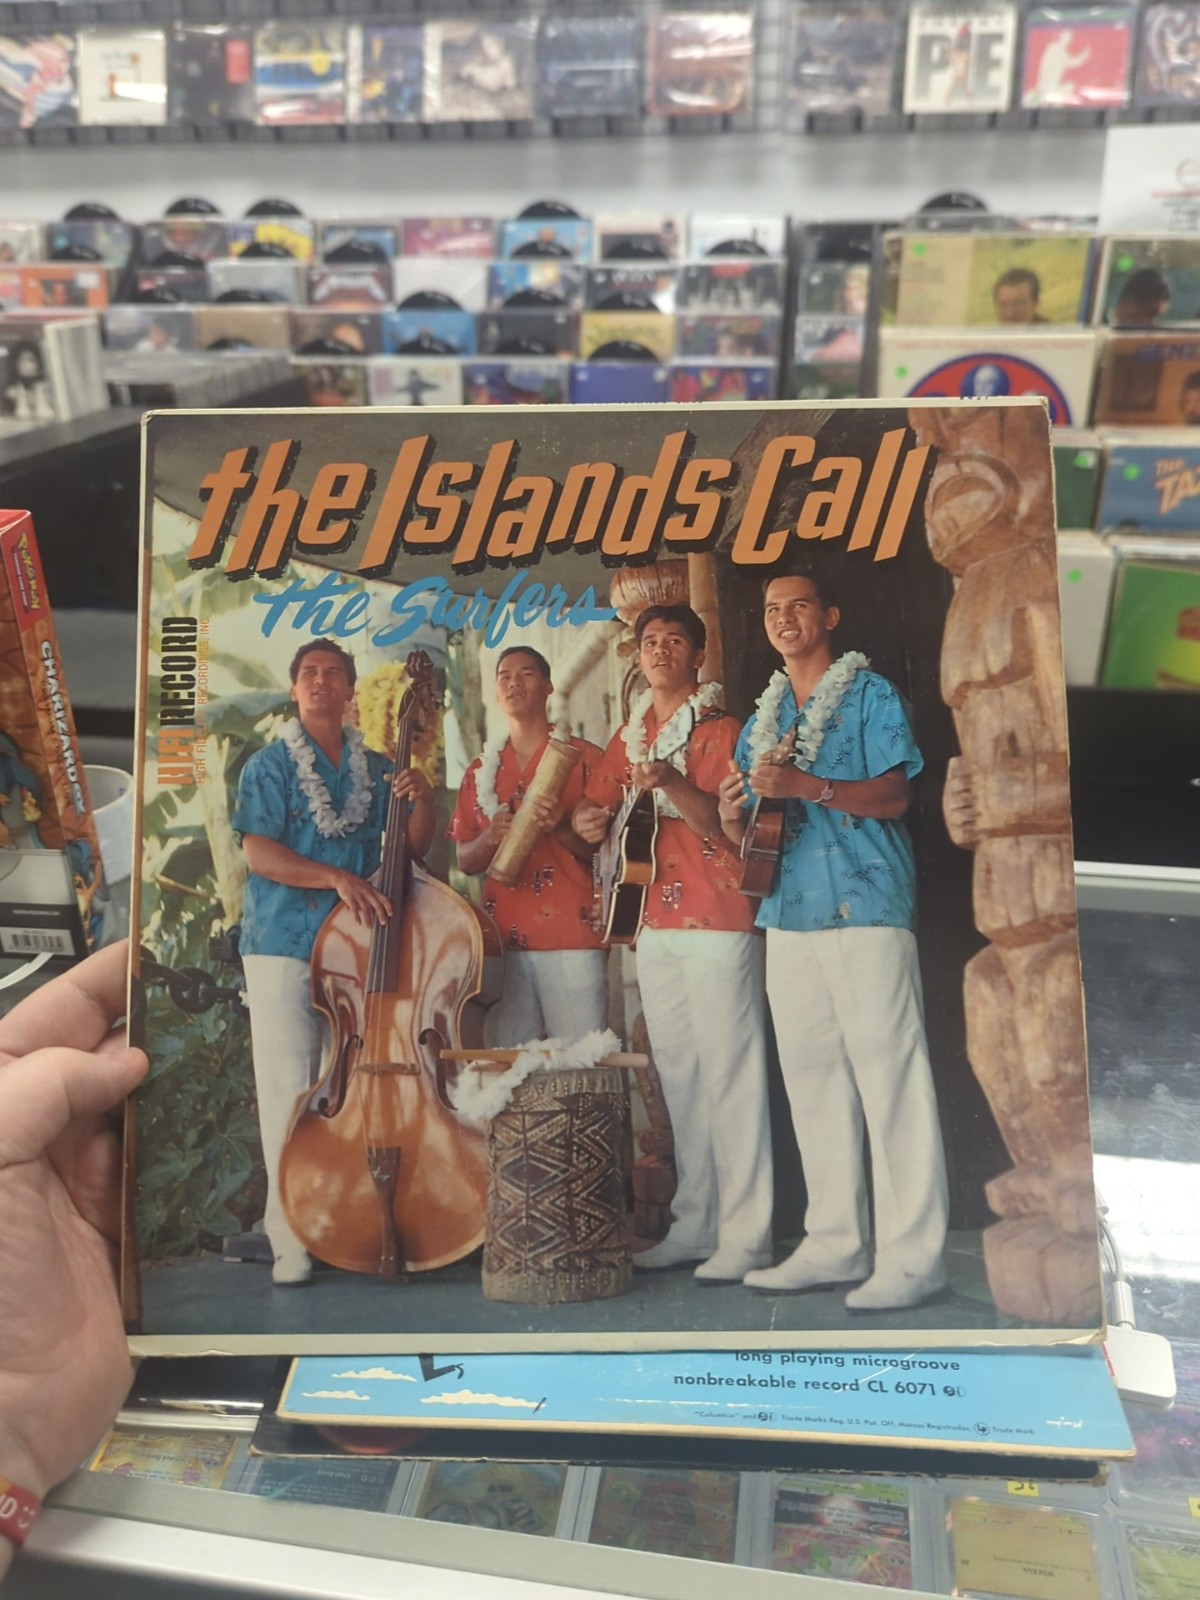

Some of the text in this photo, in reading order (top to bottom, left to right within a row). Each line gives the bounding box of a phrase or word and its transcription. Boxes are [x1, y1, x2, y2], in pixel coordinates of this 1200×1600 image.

[188, 427, 931, 575] the Islands Call
[253, 568, 618, 649] the Surfers
[41, 640, 78, 783] CHARIZARD
[197, 759, 207, 785] HIGH
[674, 1372, 936, 1396] nonbreakable record CL 6071
[735, 1352, 960, 1370] long playing microgroove
